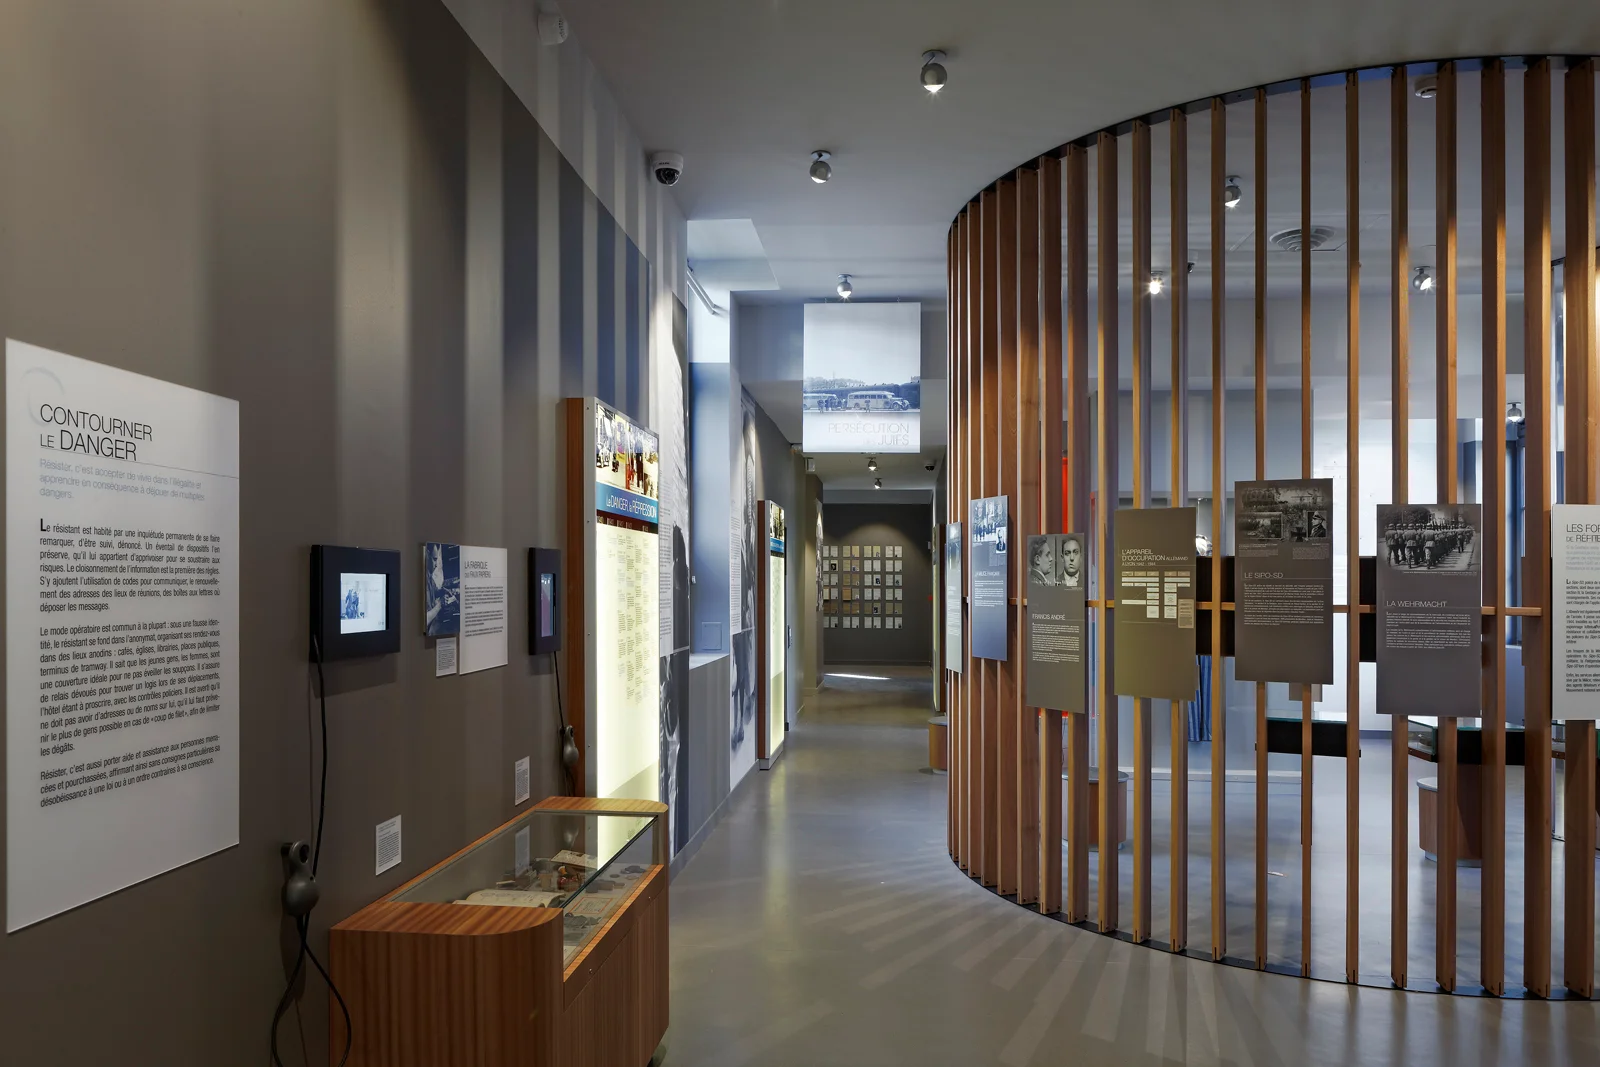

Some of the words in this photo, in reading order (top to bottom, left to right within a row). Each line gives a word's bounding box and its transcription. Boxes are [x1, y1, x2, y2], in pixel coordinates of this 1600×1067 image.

[40, 404, 152, 442] CONTOURNER
[828, 421, 909, 434] PERSÉCUTION
[40, 434, 54, 449] LE
[60, 429, 136, 462] DANGER
[878, 434, 909, 446] JUIFS
[40, 517, 51, 532] Le
[53, 523, 80, 534] résistant
[82, 526, 92, 534] est
[94, 526, 112, 536] habité
[114, 530, 123, 538] par
[1566, 524, 1583, 532] LES
[39, 538, 74, 548] remarquer,
[78, 537, 96, 547] d'être
[99, 539, 114, 550] suivi,
[39, 549, 70, 561] préserve,
[73, 550, 86, 562] qu'il
[99, 552, 128, 563] appartient
[40, 562, 65, 574] risques.
[66, 563, 74, 572] Le
[76, 563, 118, 573] cloisonnement
[119, 564, 126, 573] de
[40, 576, 50, 588] S'y
[52, 576, 78, 588] ajoutent
[80, 576, 112, 585] l'utilisation
[113, 576, 121, 585] de
[40, 589, 57, 598] ment
[59, 589, 71, 598] des
[72, 589, 100, 598] adresses
[102, 588, 113, 597] des
[114, 588, 128, 597] lieux
[128, 588, 136, 597] de
[40, 602, 66, 614] déposer
[67, 602, 77, 611] les
[78, 603, 110, 612] messages.
[40, 626, 49, 636] Le
[50, 625, 68, 635] mode
[70, 624, 101, 636] opératoire
[102, 623, 111, 632] est
[40, 639, 52, 650] tité,
[53, 639, 60, 648] le
[61, 637, 88, 648] résistant
[97, 635, 110, 645] fond
[111, 635, 125, 644] dans
[40, 653, 56, 662] dans
[58, 651, 70, 661] des
[72, 650, 87, 660] lieux
[89, 648, 112, 658] anodins
[118, 646, 134, 656] cafés,
[40, 665, 69, 676] terminus
[71, 663, 79, 673] de
[81, 662, 108, 672] tramway.
[110, 660, 113, 669] Il
[115, 658, 126, 668] sait
[40, 681, 53, 690] une
[54, 676, 88, 688] couverture
[90, 673, 108, 684] idéale
[109, 674, 122, 684] pour
[40, 693, 49, 703] de
[51, 690, 69, 701] relais
[71, 687, 96, 699] dévoués
[99, 687, 112, 697] pour
[114, 684, 134, 693] trouver
[40, 704, 60, 716] l'hôtel
[62, 702, 78, 713] étant
[79, 701, 84, 710] à
[85, 698, 112, 712] proscrire,
[114, 697, 127, 705] avec
[128, 694, 136, 703] les
[40, 722, 49, 730] ne
[50, 717, 63, 728] doit
[65, 717, 76, 728] pas
[78, 712, 93, 723] avoir
[94, 709, 126, 720] d'adresses
[40, 732, 49, 743] nir
[51, 731, 57, 741] le
[58, 729, 72, 742] plus
[73, 727, 82, 737] de
[83, 726, 98, 738] gens
[99, 720, 122, 735] possible
[40, 747, 50, 756] les
[51, 742, 75, 755] dégâts.
[40, 767, 67, 780] Résister,
[69, 762, 85, 774] c'est
[86, 758, 102, 770] aussi
[104, 755, 121, 768] porter
[122, 752, 134, 762] aide
[40, 782, 56, 794] cées
[57, 779, 64, 790] et
[65, 771, 108, 790] pourchassées,
[109, 763, 134, 777] affirmant
[40, 789, 87, 807] désobéissance
[88, 785, 93, 795] à
[94, 784, 105, 794] une
[123, 777, 127, 786] à
